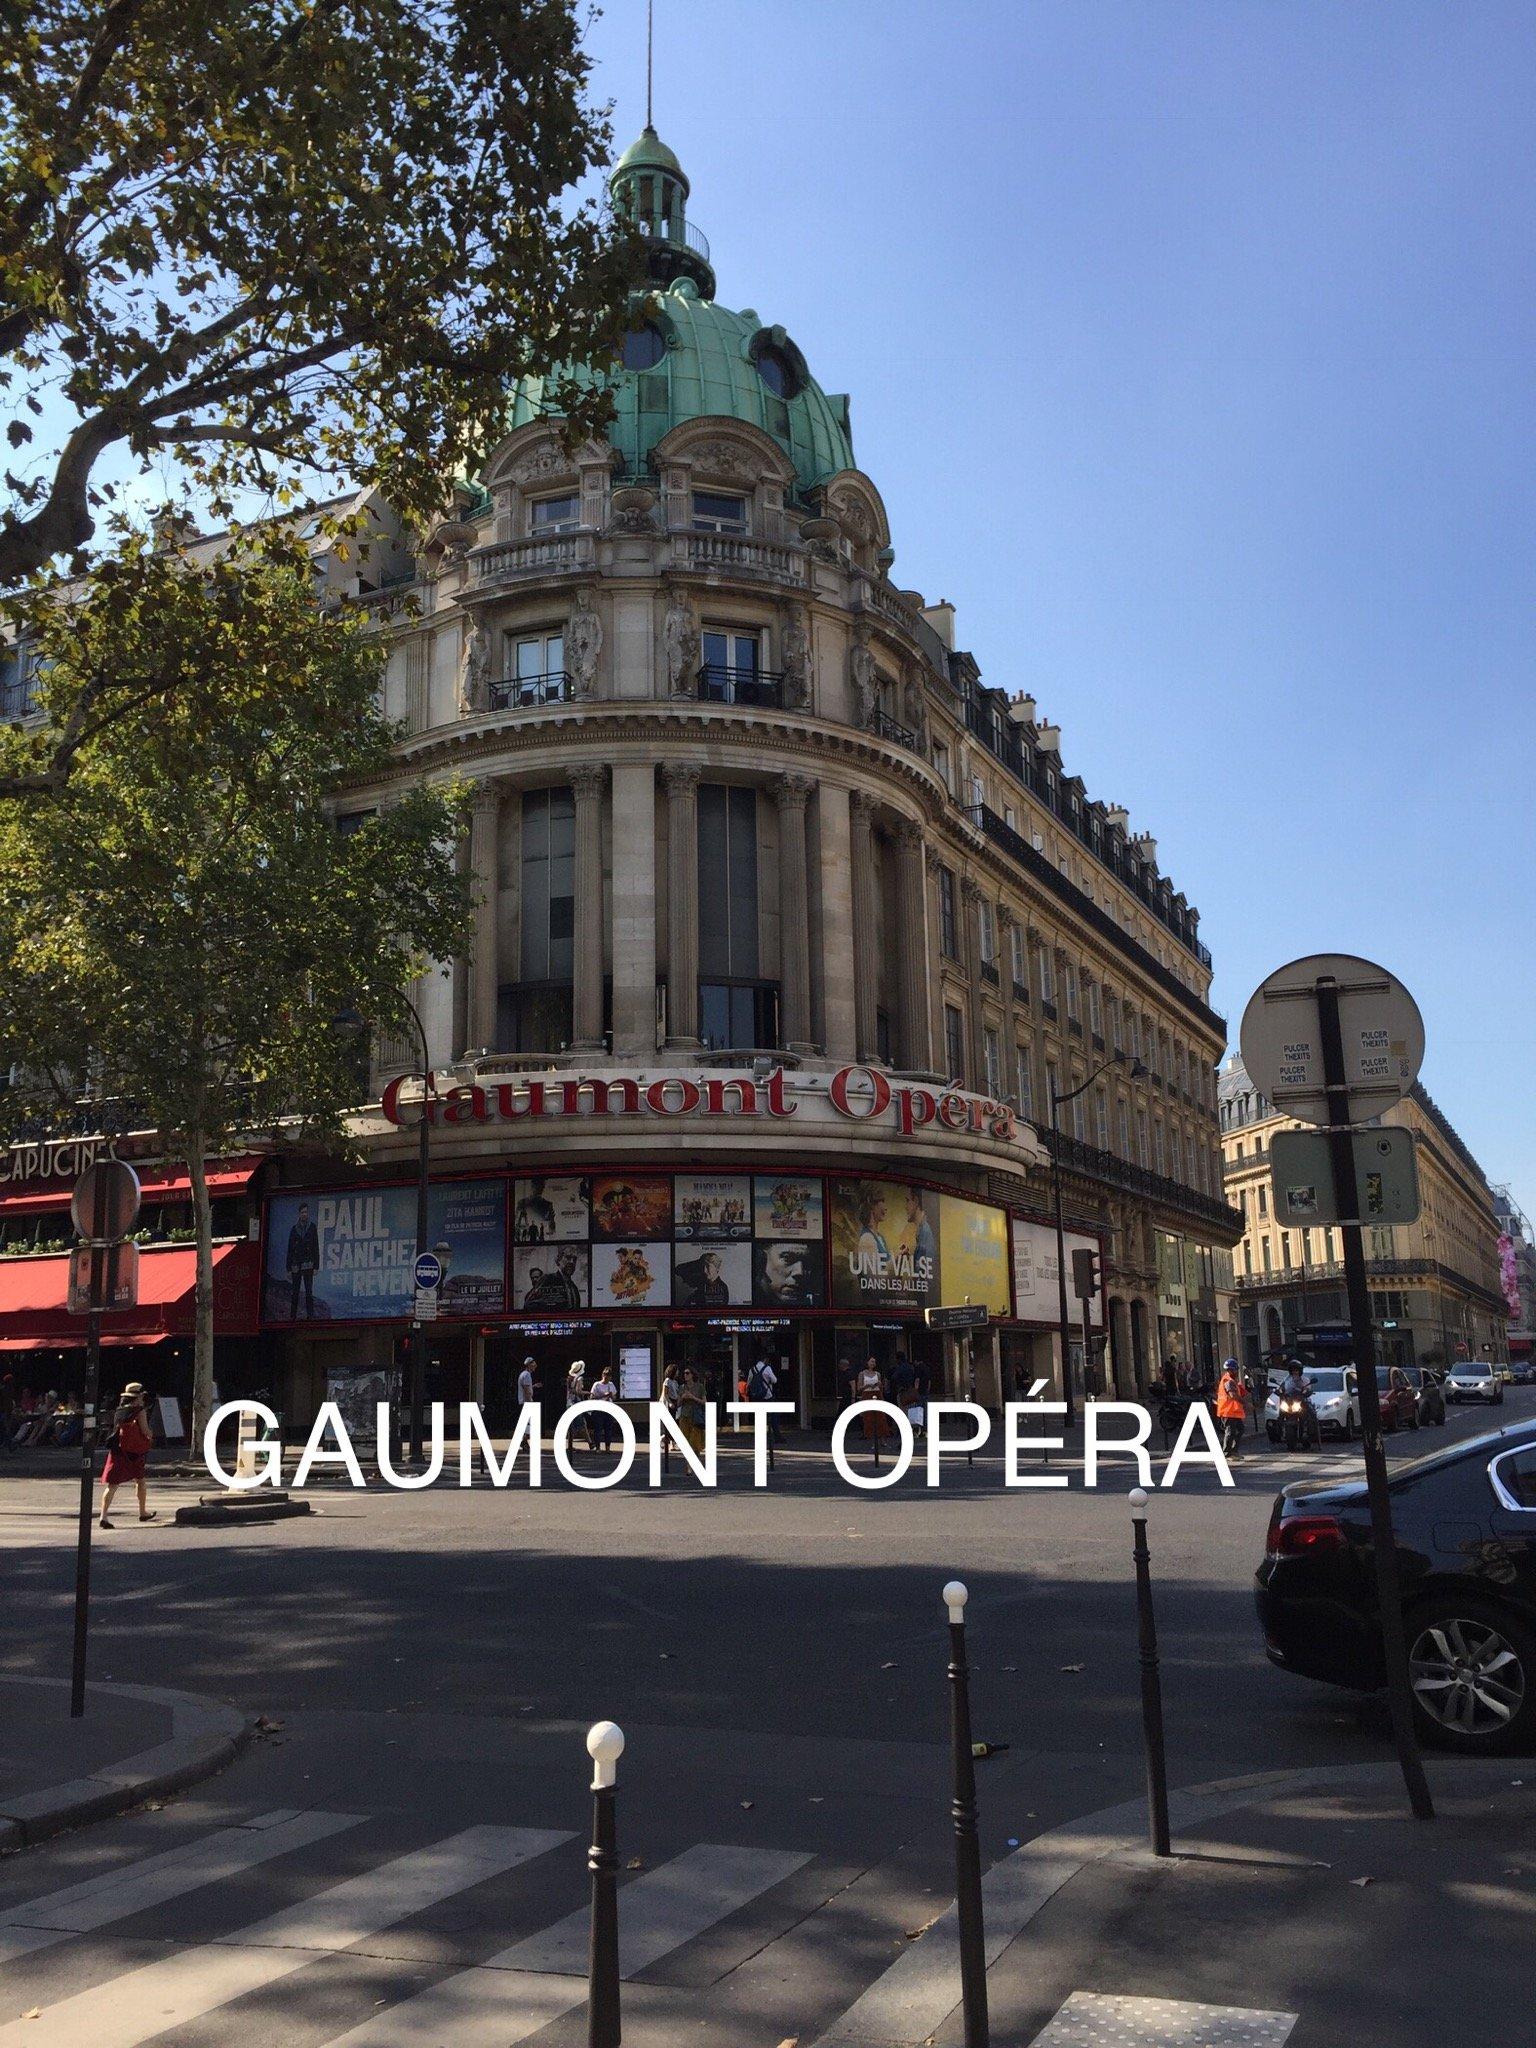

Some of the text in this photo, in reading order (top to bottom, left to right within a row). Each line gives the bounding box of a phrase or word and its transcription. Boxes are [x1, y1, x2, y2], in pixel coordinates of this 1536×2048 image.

[382, 1065, 1017, 1140] Gaumont Opéra
[317, 1196, 390, 1262] PAUL
[327, 1238, 418, 1270] SANCHEZ
[849, 1251, 934, 1280] UNE VALSE
[353, 1266, 416, 1296] REVEN
[461, 1285, 468, 1295] LE
[478, 1283, 502, 1294] JUILLET
[860, 1278, 929, 1293] DANS LES ALLÉES
